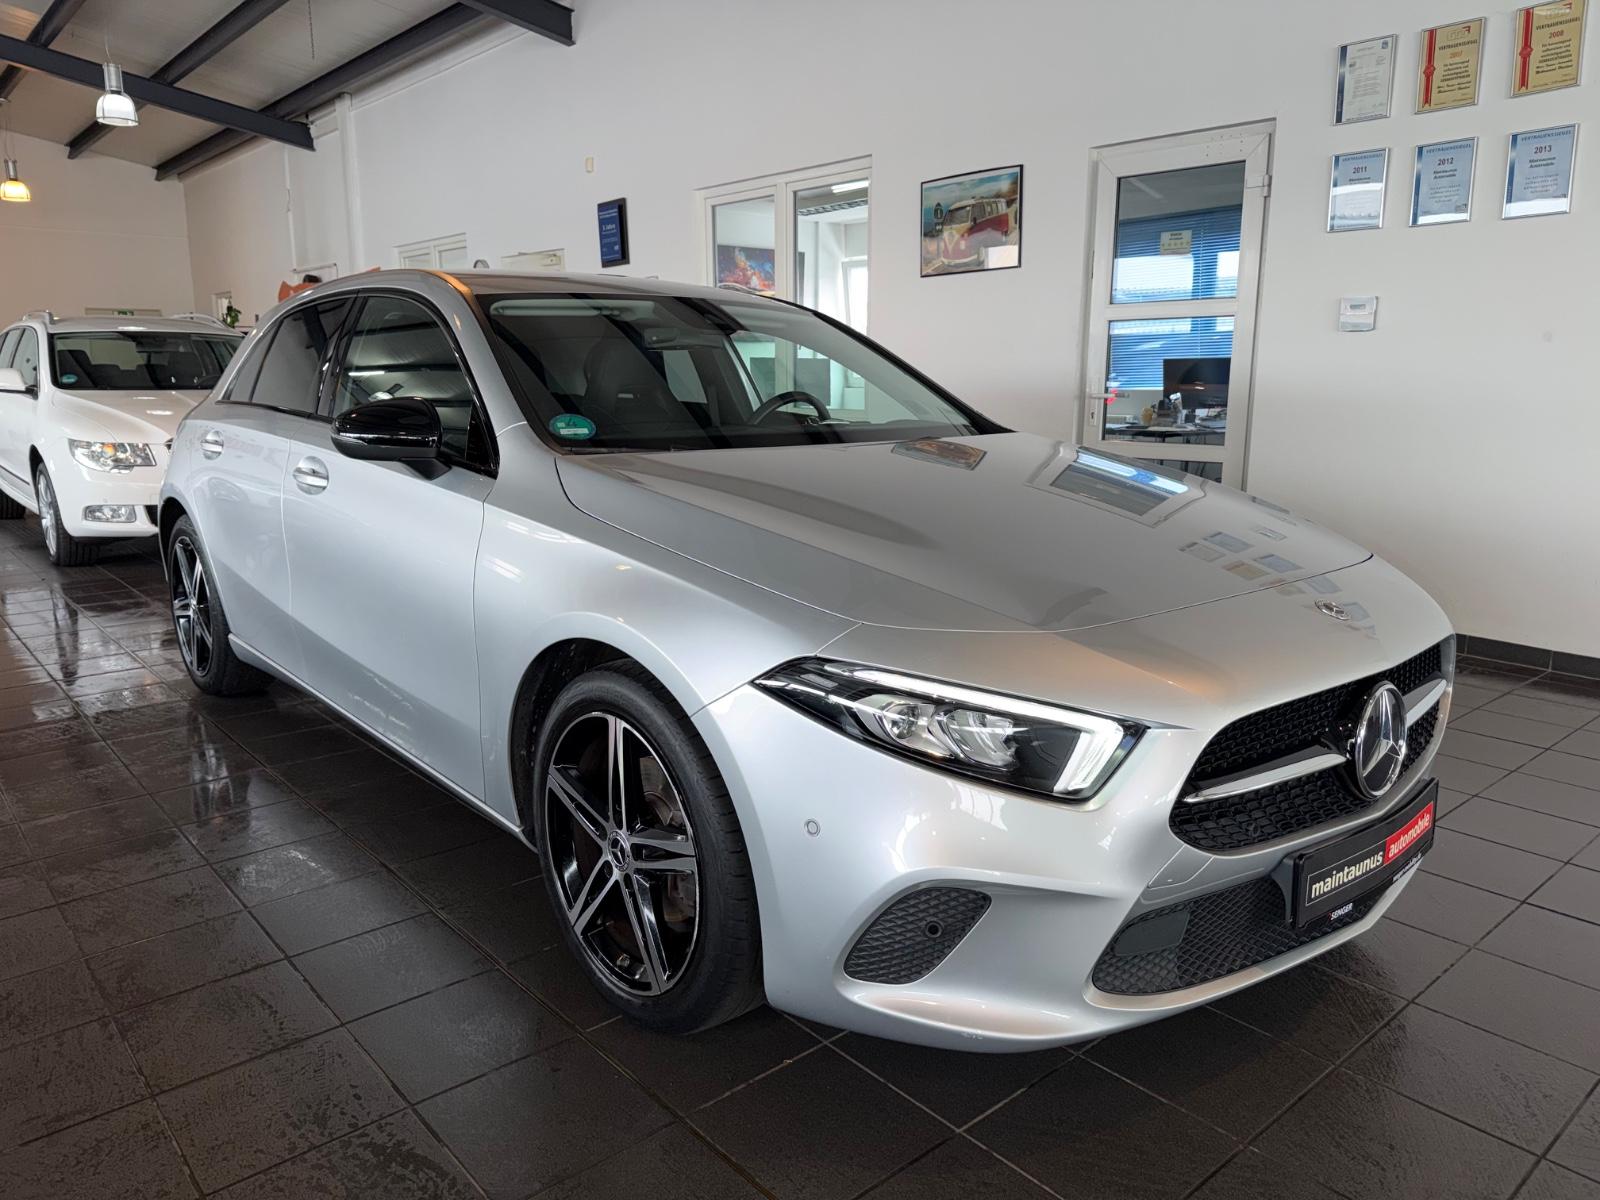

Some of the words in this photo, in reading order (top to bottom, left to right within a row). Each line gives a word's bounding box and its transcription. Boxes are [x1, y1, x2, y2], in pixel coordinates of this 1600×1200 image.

[1548, 30, 1565, 39] 2008
[1534, 145, 1552, 154] 2013
[1437, 157, 1454, 166] 2012
[1352, 166, 1368, 174] 2011
[1310, 850, 1384, 899] maintaunus
[1388, 813, 1431, 858] automobile
[1330, 902, 1353, 920] SENGER
